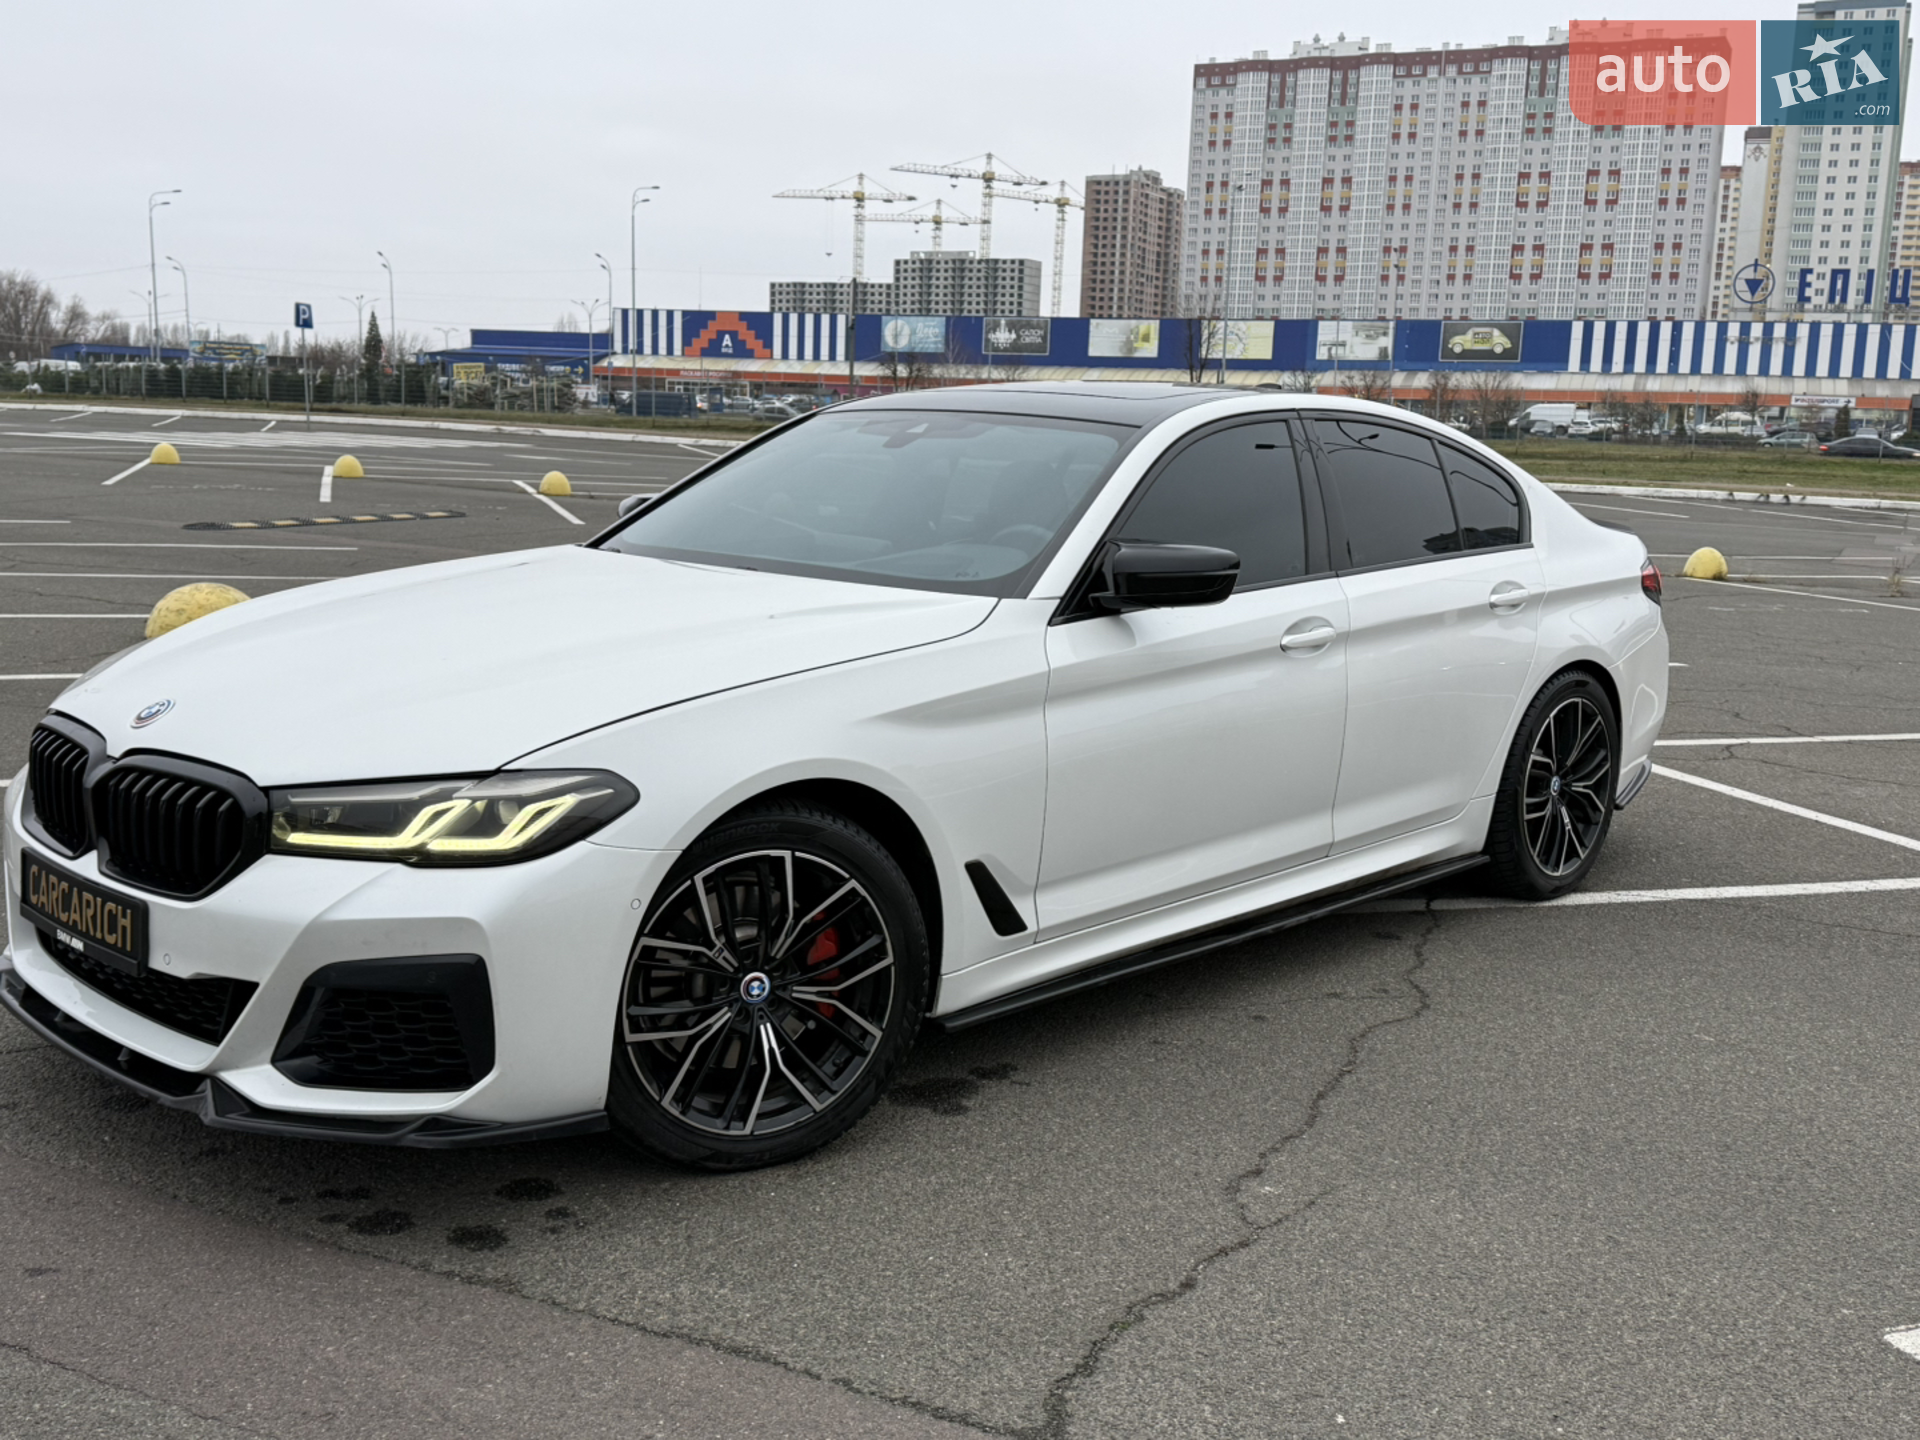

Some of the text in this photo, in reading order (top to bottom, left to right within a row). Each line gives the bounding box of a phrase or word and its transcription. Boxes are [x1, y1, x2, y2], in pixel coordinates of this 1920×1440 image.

[1796, 267, 1912, 307] ЕПІЦ
[299, 304, 310, 326] P
[29, 864, 132, 952] CARCARICH
